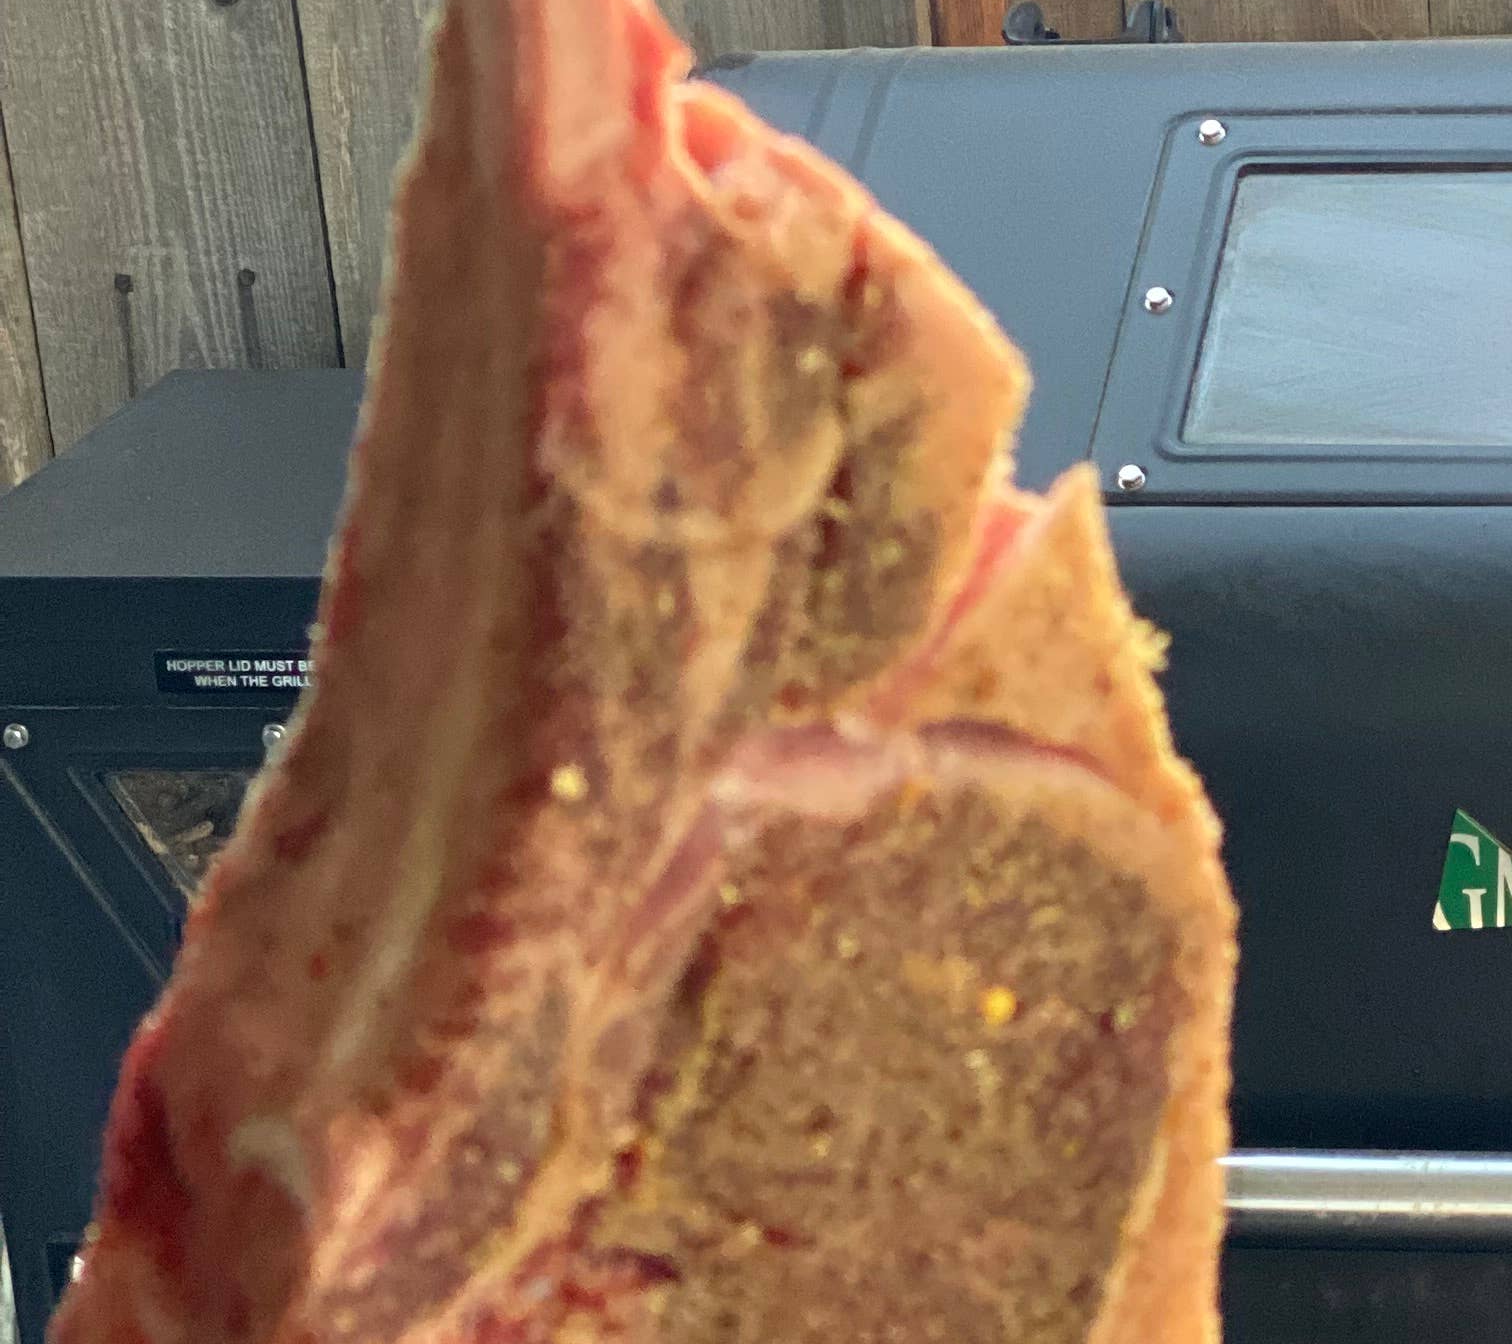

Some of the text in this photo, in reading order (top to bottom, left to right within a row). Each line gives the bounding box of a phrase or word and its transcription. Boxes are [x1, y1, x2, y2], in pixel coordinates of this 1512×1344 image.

[166, 659, 225, 672] HOPPER
[228, 659, 251, 672] LID
[254, 660, 294, 672] MUST
[194, 675, 313, 688] WHEN THE GRILL
